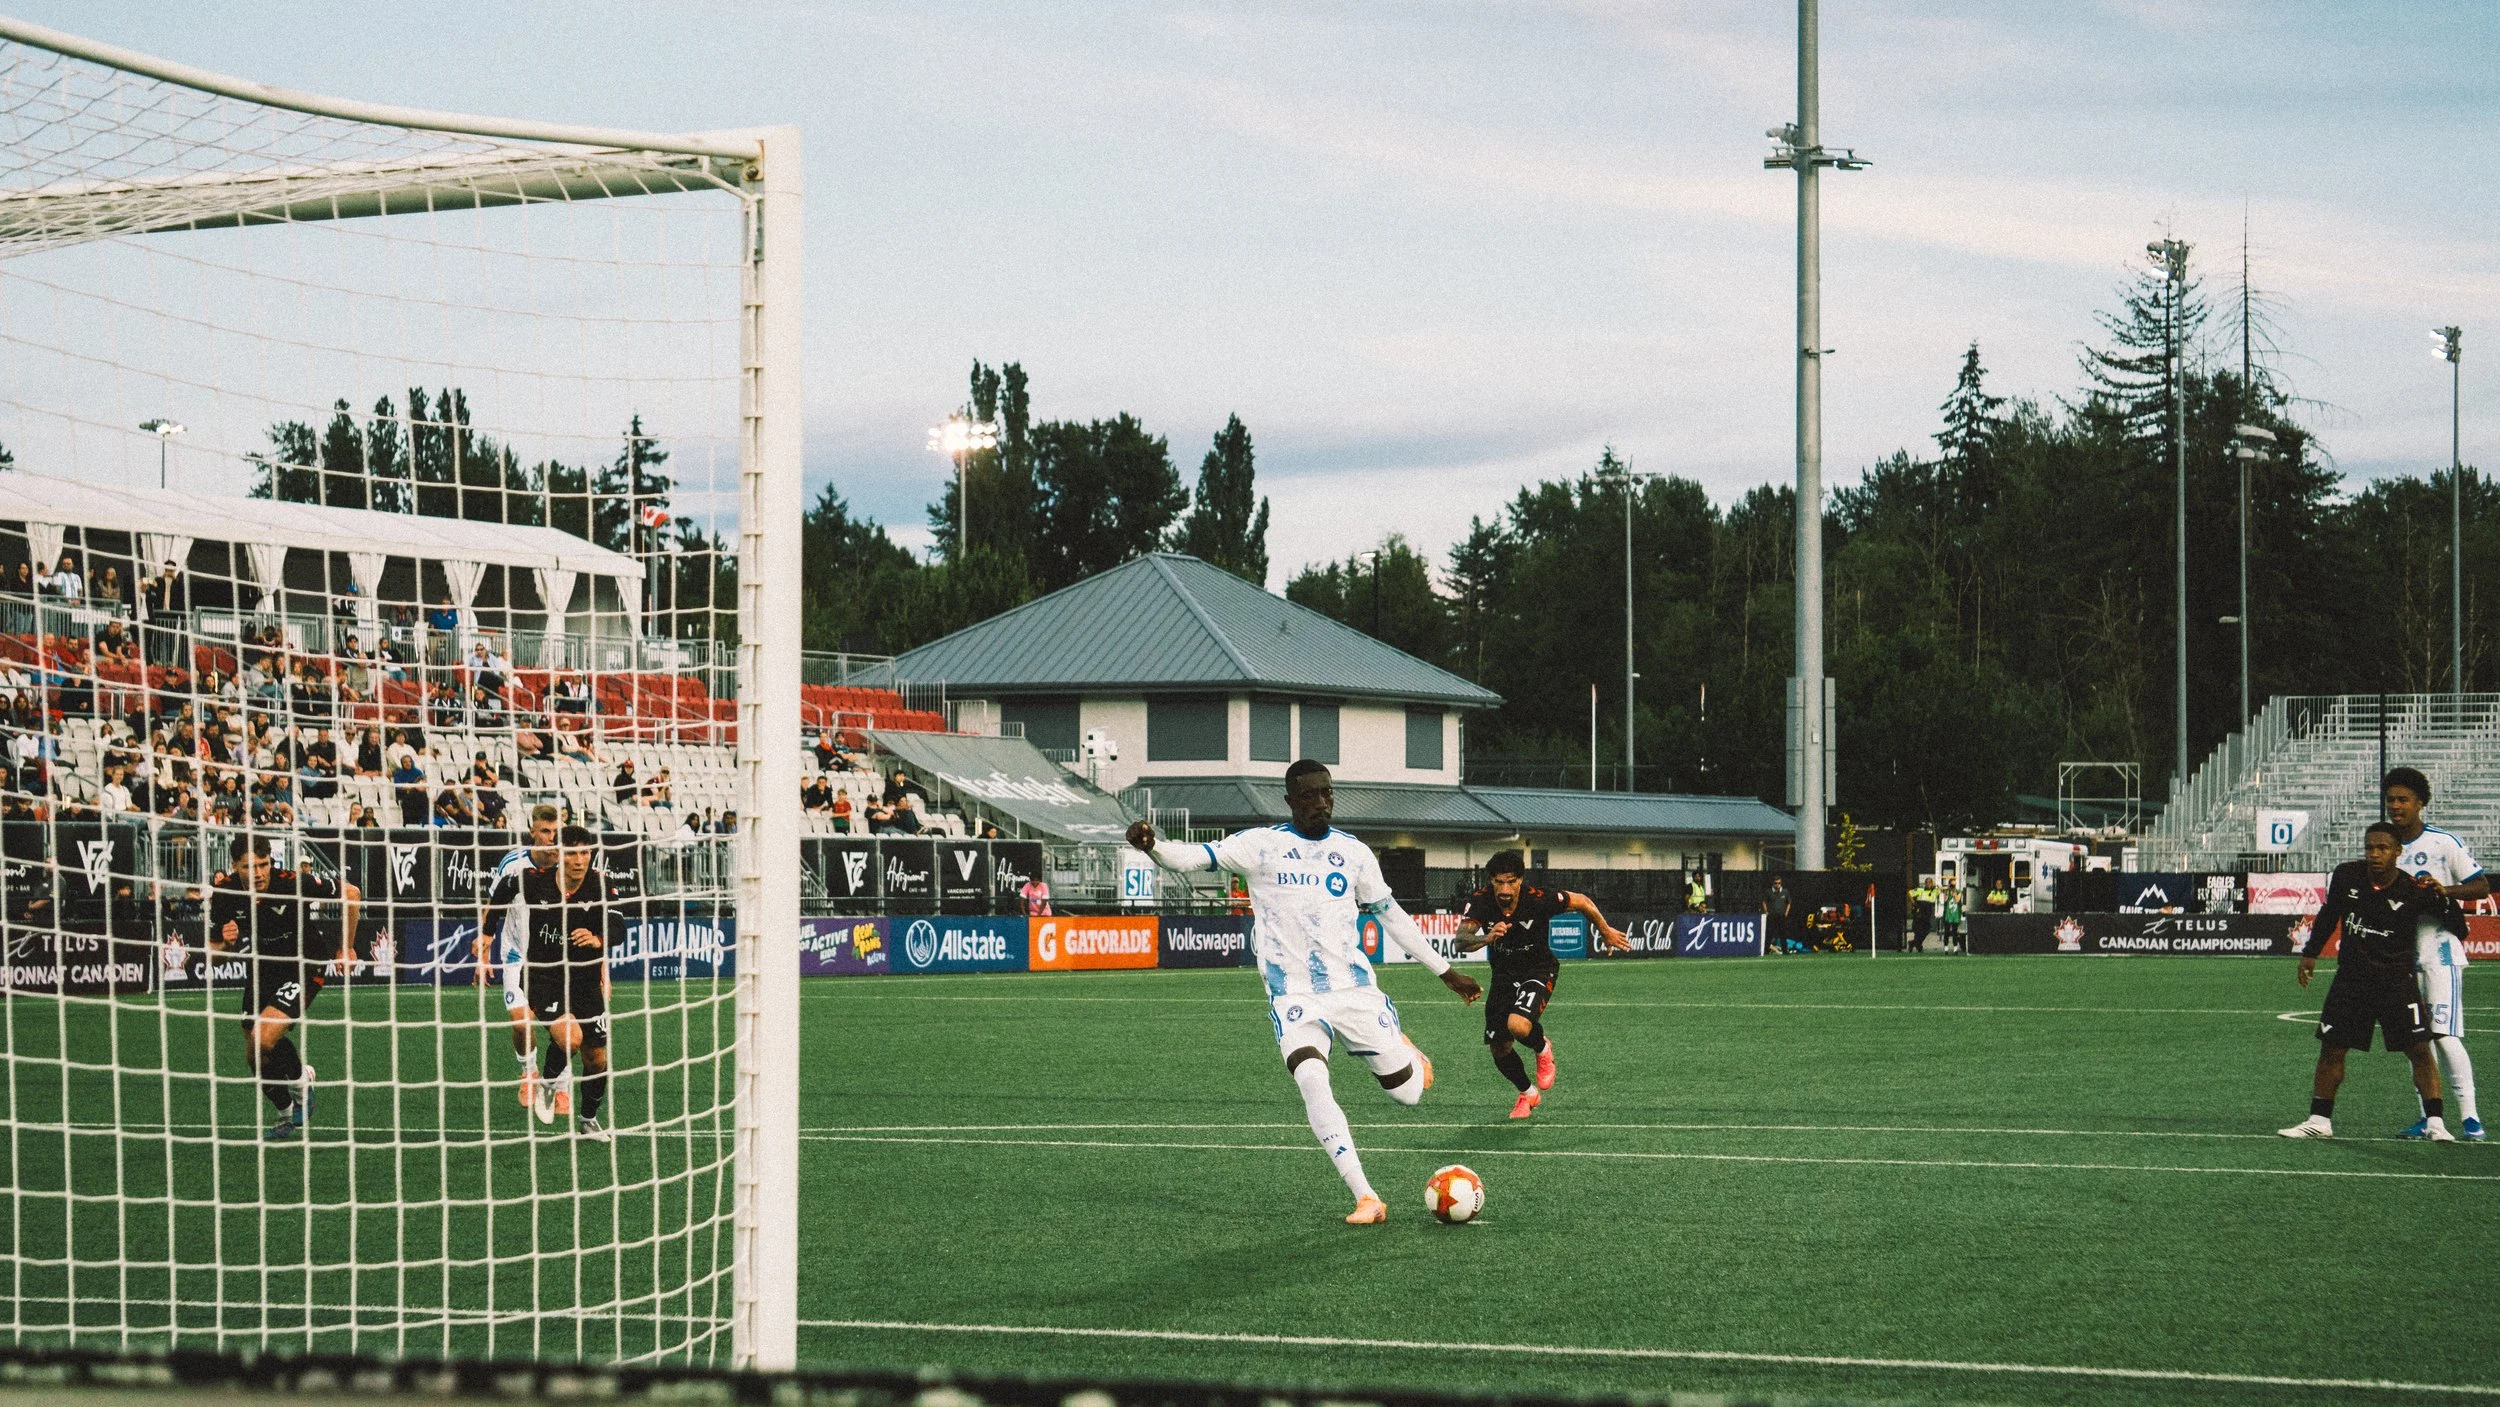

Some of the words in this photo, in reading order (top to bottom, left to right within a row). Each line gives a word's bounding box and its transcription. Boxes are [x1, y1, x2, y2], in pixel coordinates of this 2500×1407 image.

[1277, 872, 1320, 887] BMO
[1643, 919, 1674, 951] Club
[1711, 921, 1755, 943] TELUS
[2174, 919, 2228, 931] TELUS
[810, 928, 848, 952] ACTIVE
[937, 929, 1006, 961] Allstate
[1064, 929, 1151, 956] GATORADE
[1167, 927, 1246, 957] Volkswagen
[2099, 936, 2169, 950] CANADIAN
[2172, 937, 2272, 951] CHAMPIONSHIP
[2462, 941, 2500, 954] NADI
[71, 964, 143, 983] CANADIEN
[194, 961, 248, 980] CANADI
[275, 981, 301, 1001] 23
[1514, 990, 1537, 1009] 21
[2407, 1002, 2420, 1026] 1
[2431, 1003, 2450, 1025] 5
